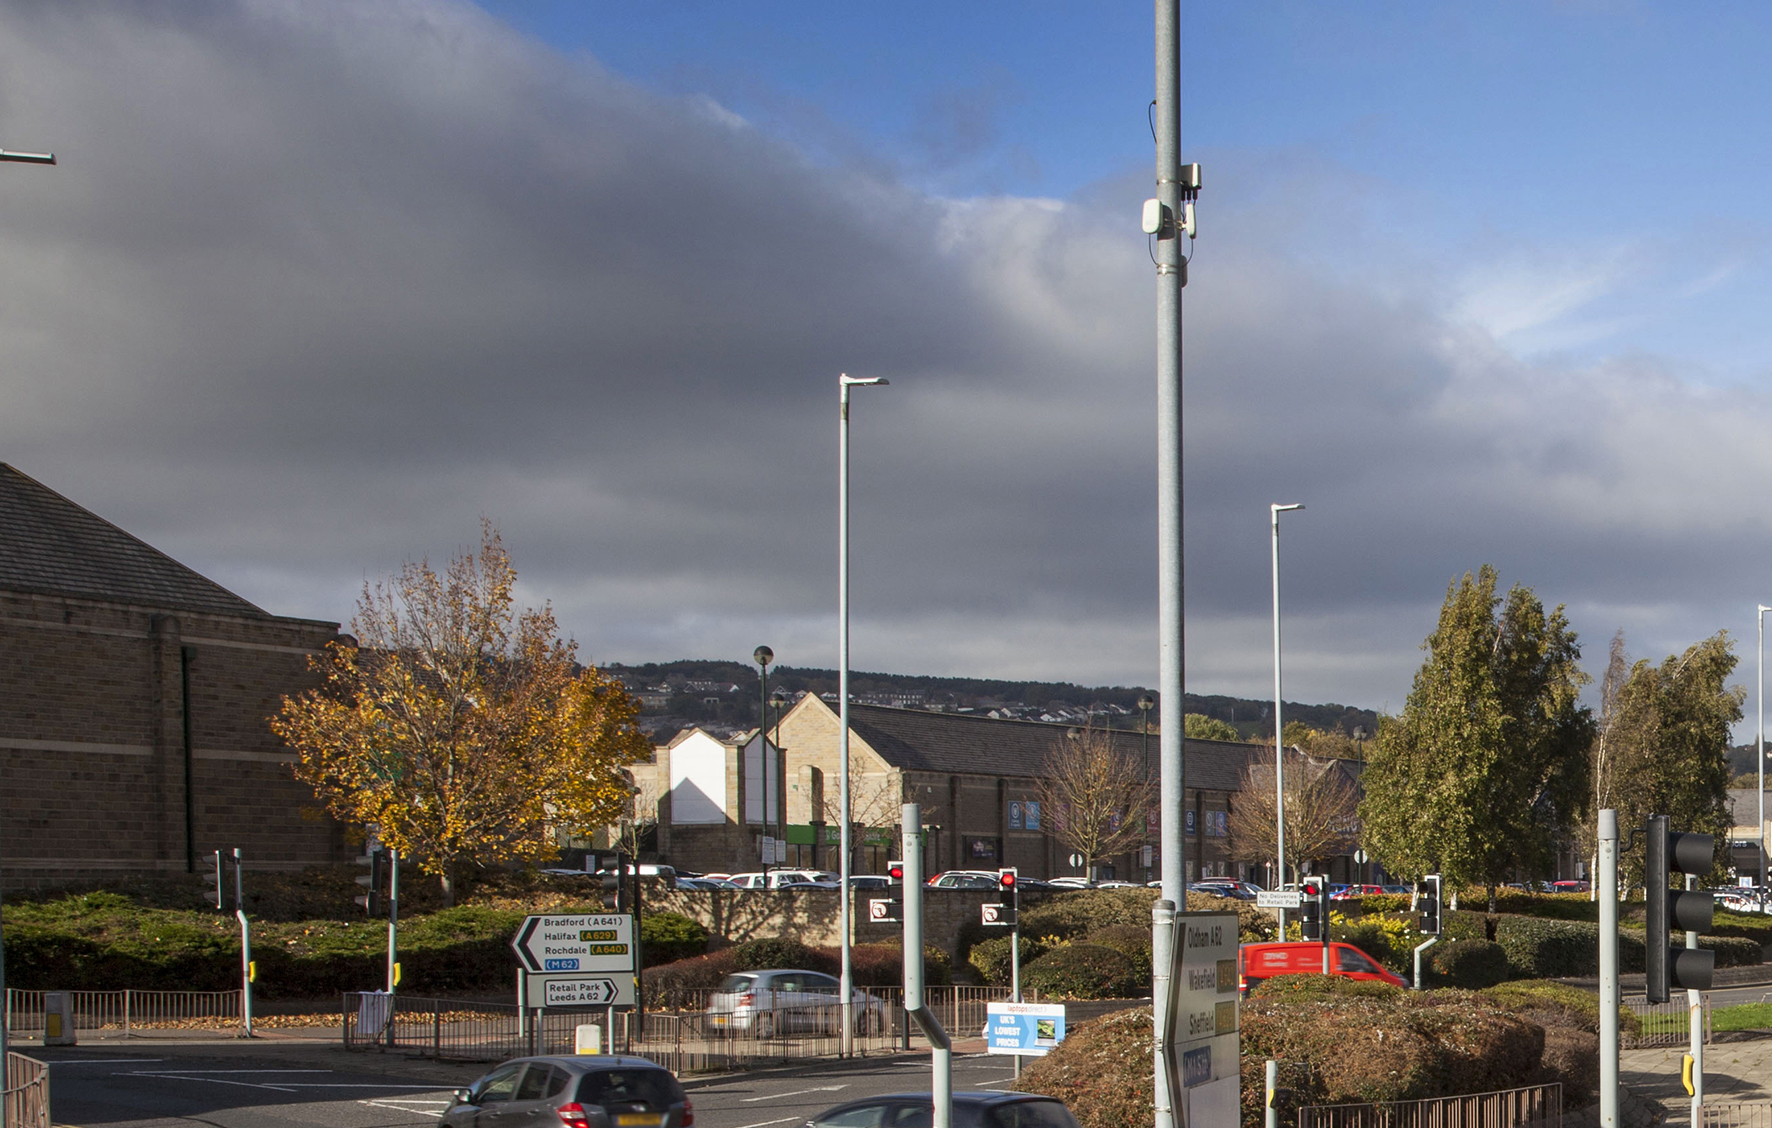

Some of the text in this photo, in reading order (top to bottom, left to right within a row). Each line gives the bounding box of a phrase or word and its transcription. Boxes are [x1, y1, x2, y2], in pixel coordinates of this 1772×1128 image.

[544, 918, 585, 927] Bradford
[544, 932, 577, 940] Halifax
[1188, 926, 1210, 948] Oldham
[545, 946, 588, 955] Rochdale
[1189, 967, 1216, 991] Wakefield
[549, 983, 600, 992] Retail Park
[550, 993, 577, 1001] Leeds
[999, 1015, 1016, 1025] UK'S
[1190, 1011, 1215, 1035] Sheffield
[994, 1026, 1021, 1036] LOWEST
[996, 1037, 1020, 1048] PRICES
